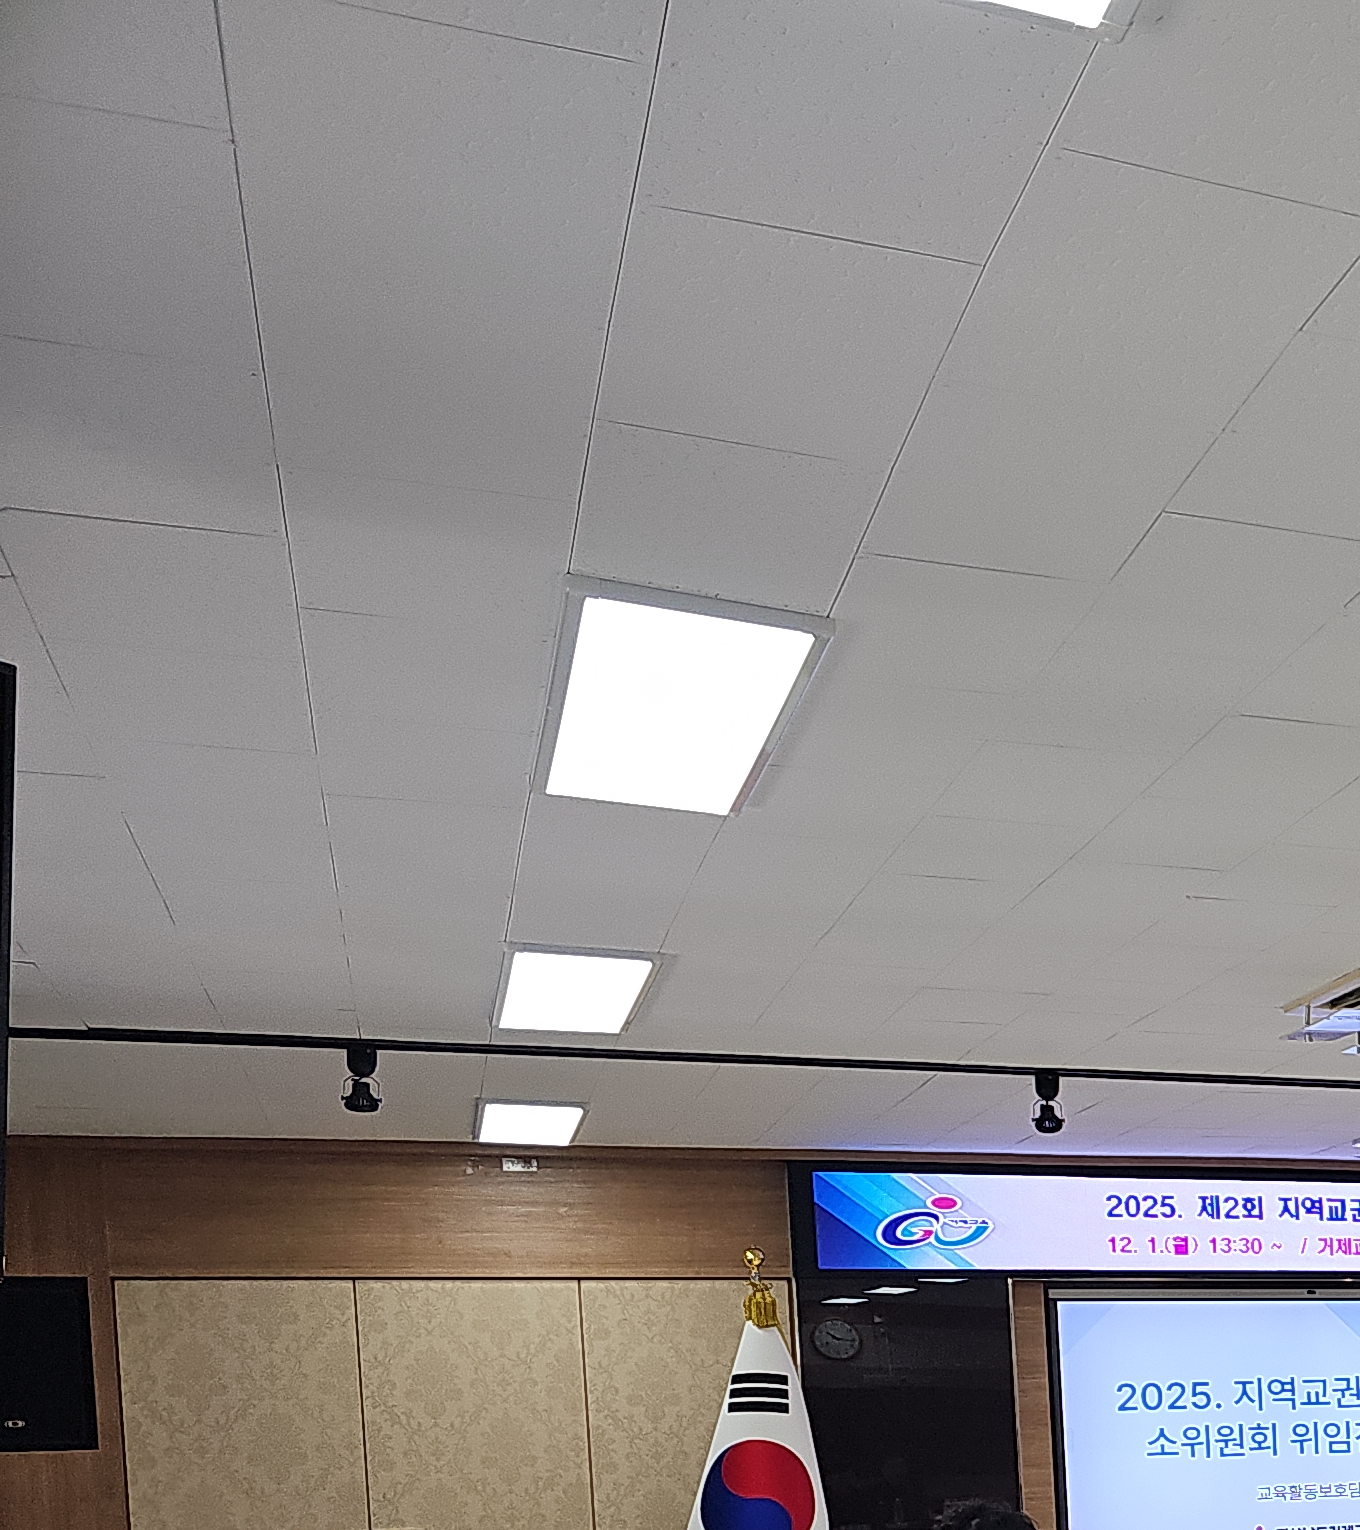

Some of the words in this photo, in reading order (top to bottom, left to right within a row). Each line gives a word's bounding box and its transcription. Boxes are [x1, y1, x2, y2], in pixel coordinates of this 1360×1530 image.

[1106, 1195, 1183, 1218] 2025.
[1197, 1195, 1264, 1220] 제2회
[1108, 1236, 1138, 1253] 12.
[1209, 1237, 1263, 1254] 13:30
[1116, 1382, 1222, 1412] 2025.
[1147, 1424, 1278, 1458] 소위원회
